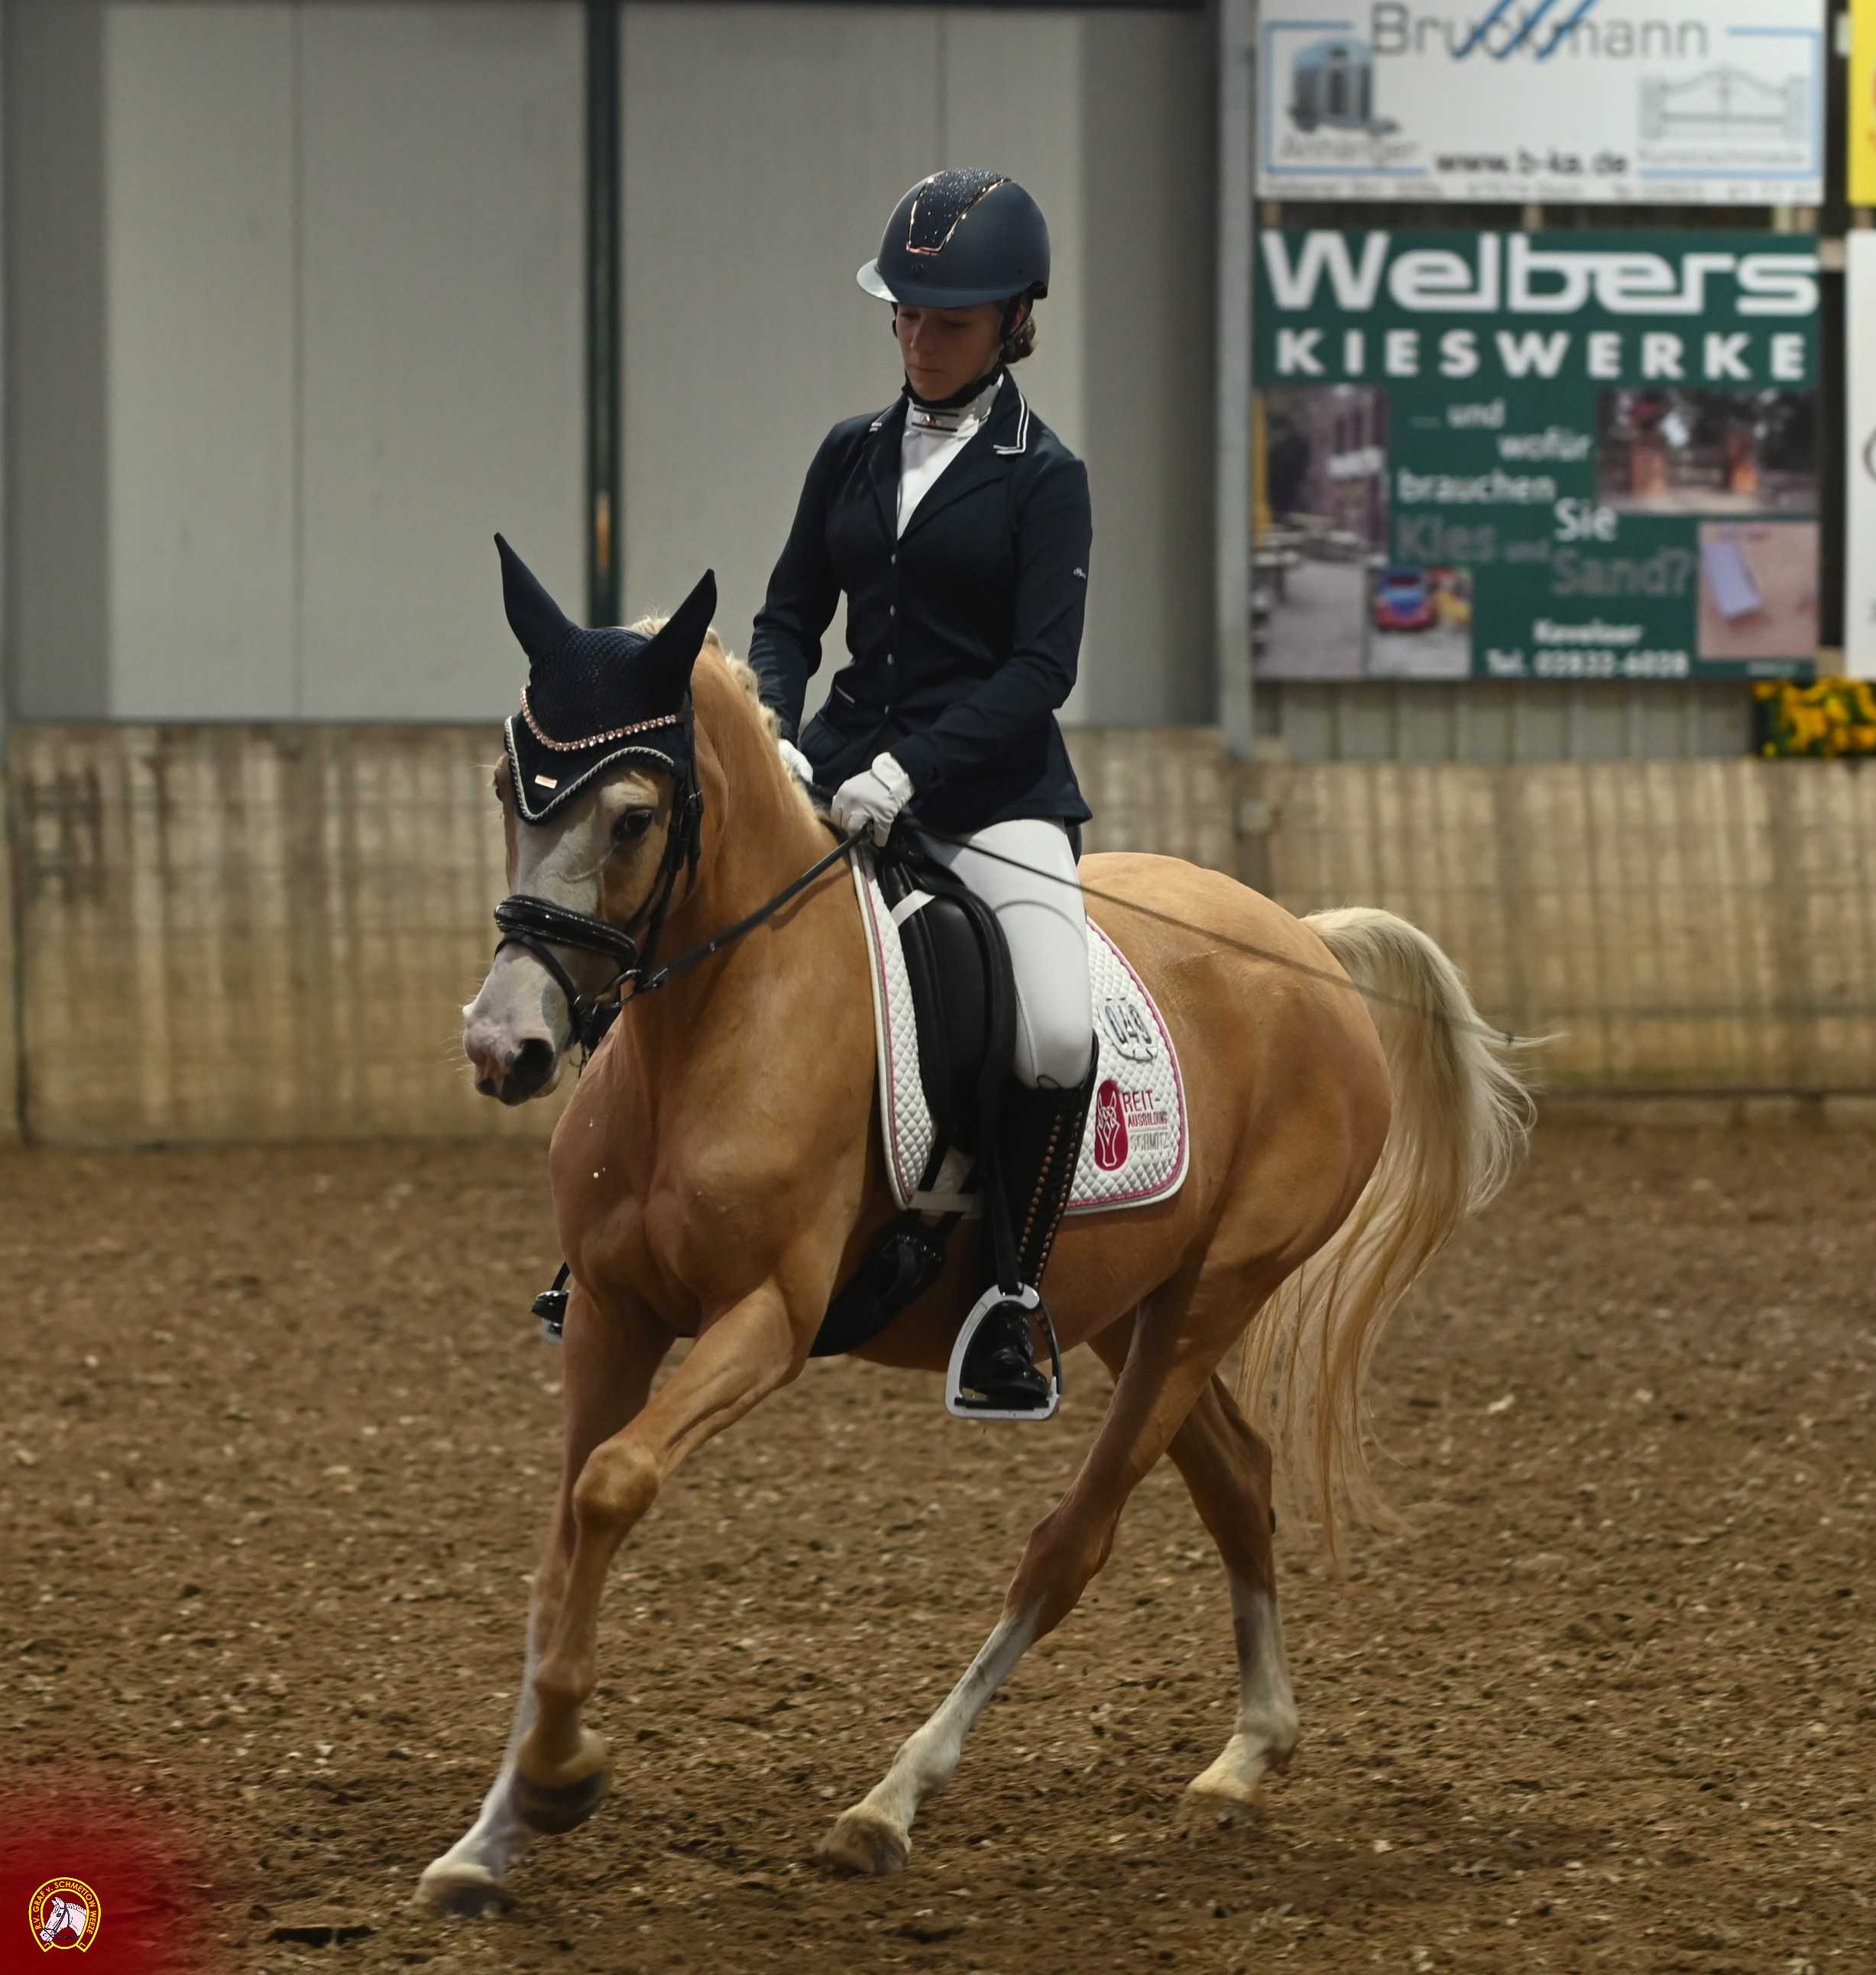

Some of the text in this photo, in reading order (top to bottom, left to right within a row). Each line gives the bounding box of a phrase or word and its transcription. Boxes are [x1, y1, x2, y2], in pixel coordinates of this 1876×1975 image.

[1260, 230, 1821, 315] Welbers
[1276, 329, 1806, 380] KIESWERKE
[1447, 397, 1506, 429] und
[1496, 424, 1594, 461] wofür
[1396, 467, 1557, 504] brauchen
[1396, 513, 1498, 562] Kies
[1554, 496, 1618, 542] Sie
[1551, 545, 1693, 596] Sand?
[1122, 1089, 1161, 1112] REIT-
[1128, 1111, 1168, 1128] AUSBILDUNG
